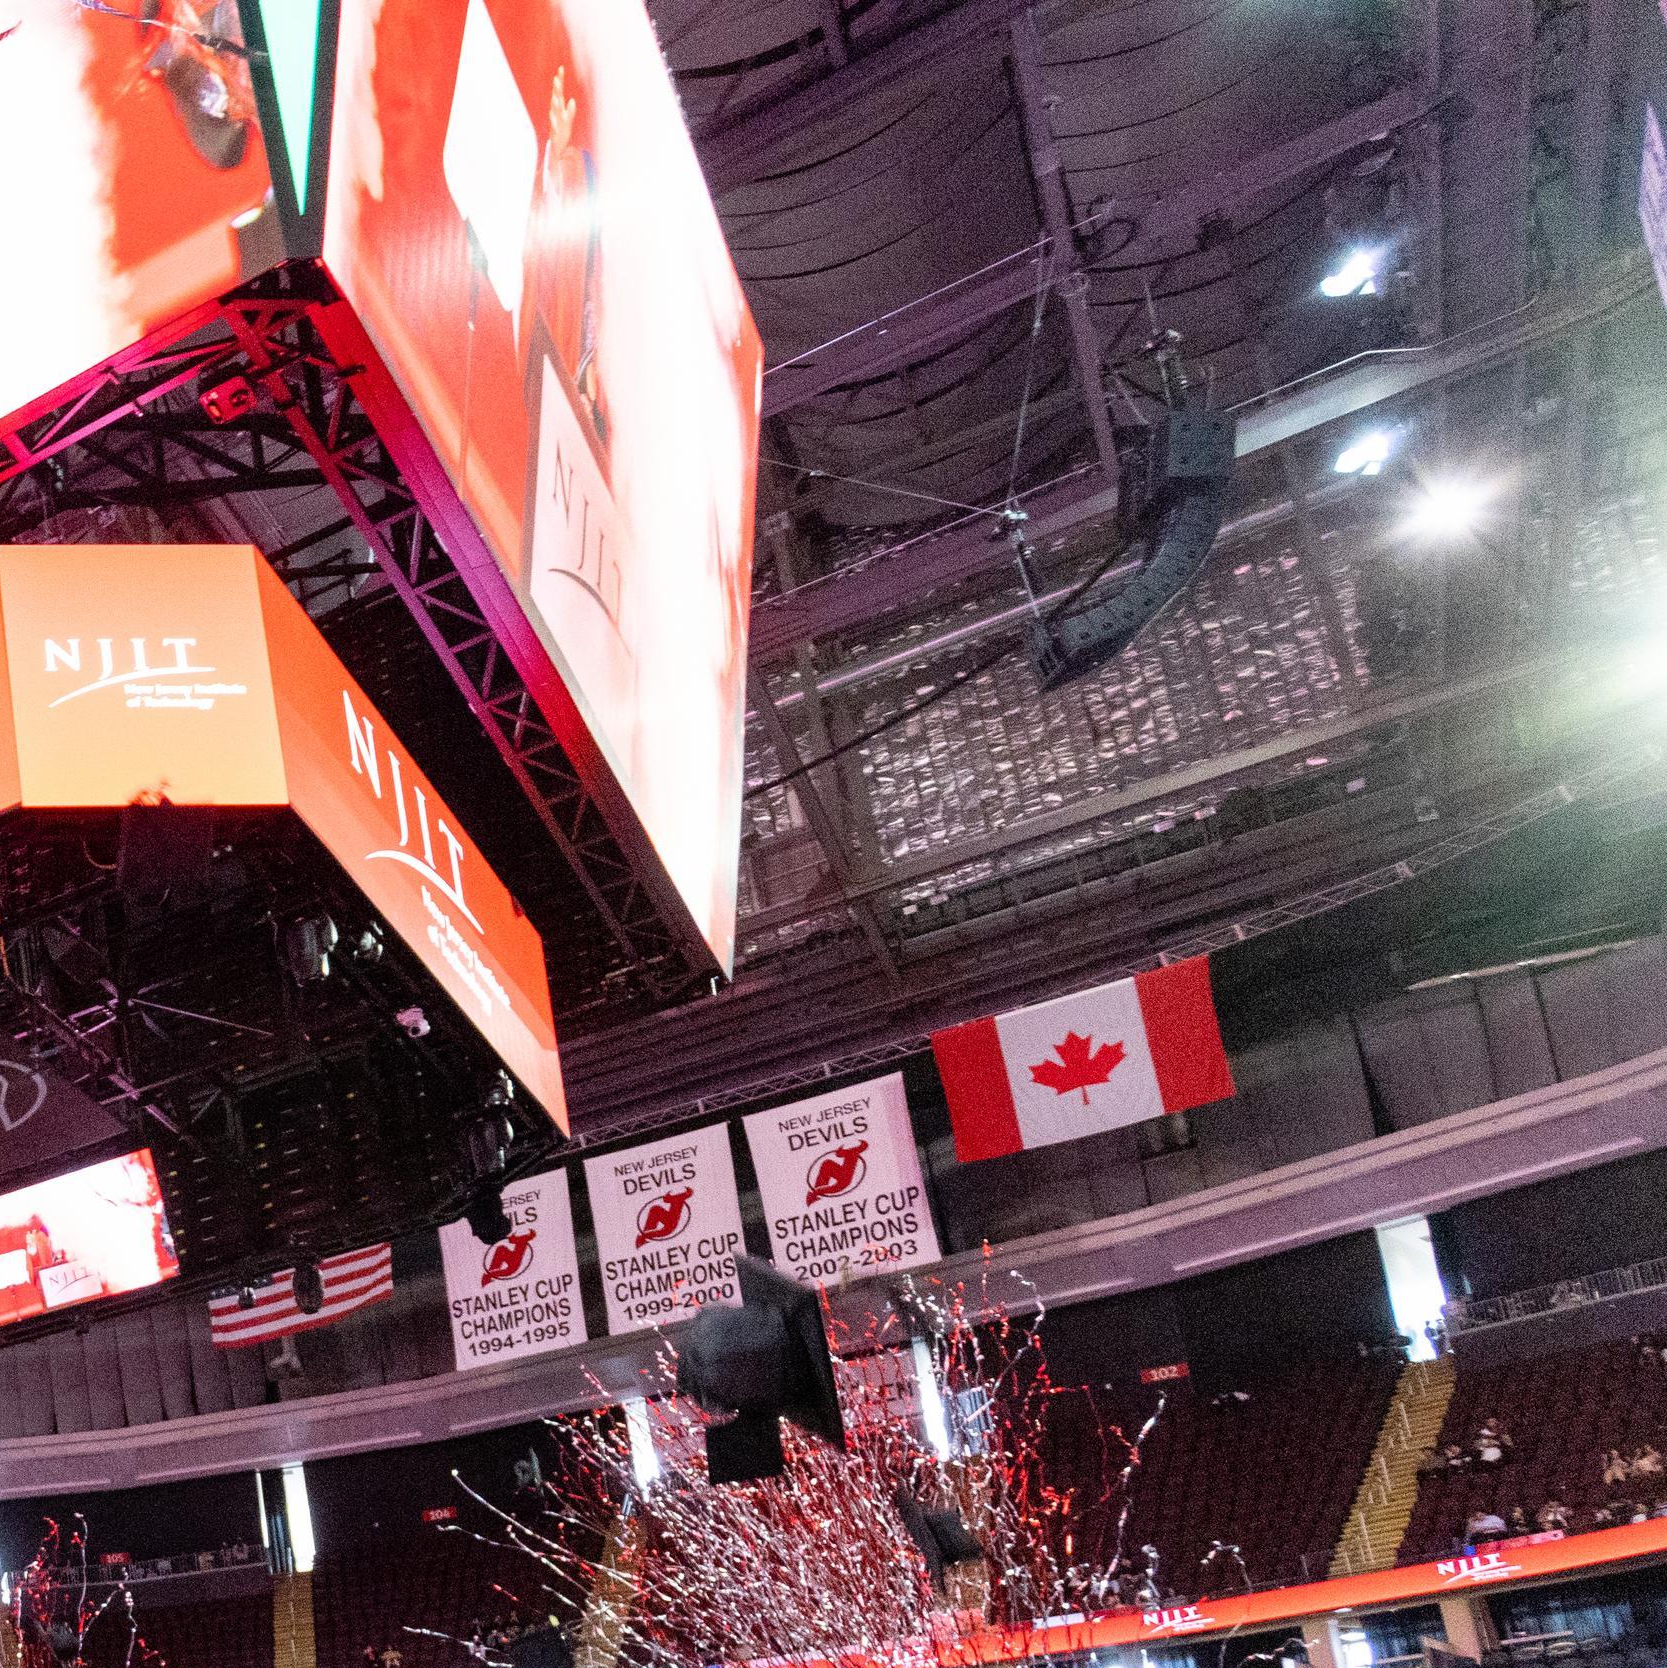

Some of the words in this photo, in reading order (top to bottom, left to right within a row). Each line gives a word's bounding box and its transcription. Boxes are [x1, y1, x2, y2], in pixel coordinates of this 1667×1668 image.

[44, 638, 197, 681] NJIT
[343, 690, 465, 901] NJIT
[778, 1116, 810, 1134] NEW
[812, 1097, 873, 1128] JERSEY
[786, 1115, 869, 1153] DEVILS
[614, 1160, 641, 1178] NEW
[643, 1145, 698, 1171] JERSEY
[622, 1163, 697, 1196] DEVILS
[501, 1189, 541, 1209] ERSEY
[774, 1201, 868, 1241] STANLEY
[872, 1186, 921, 1216] CUP
[604, 1241, 690, 1281] STANLEY
[694, 1231, 740, 1256] CUP
[785, 1211, 919, 1264] CHAMPIONS
[452, 1283, 529, 1319] STANLEY
[535, 1273, 573, 1299] CUP
[615, 1257, 738, 1303] CHAMPIONS
[460, 1298, 572, 1340] CHAMPIONS
[622, 1282, 736, 1323] 1999-2000
[468, 1321, 571, 1357] 1994-1995
[1436, 1552, 1501, 1576] NJIT
[1143, 1605, 1204, 1628] NJIT
